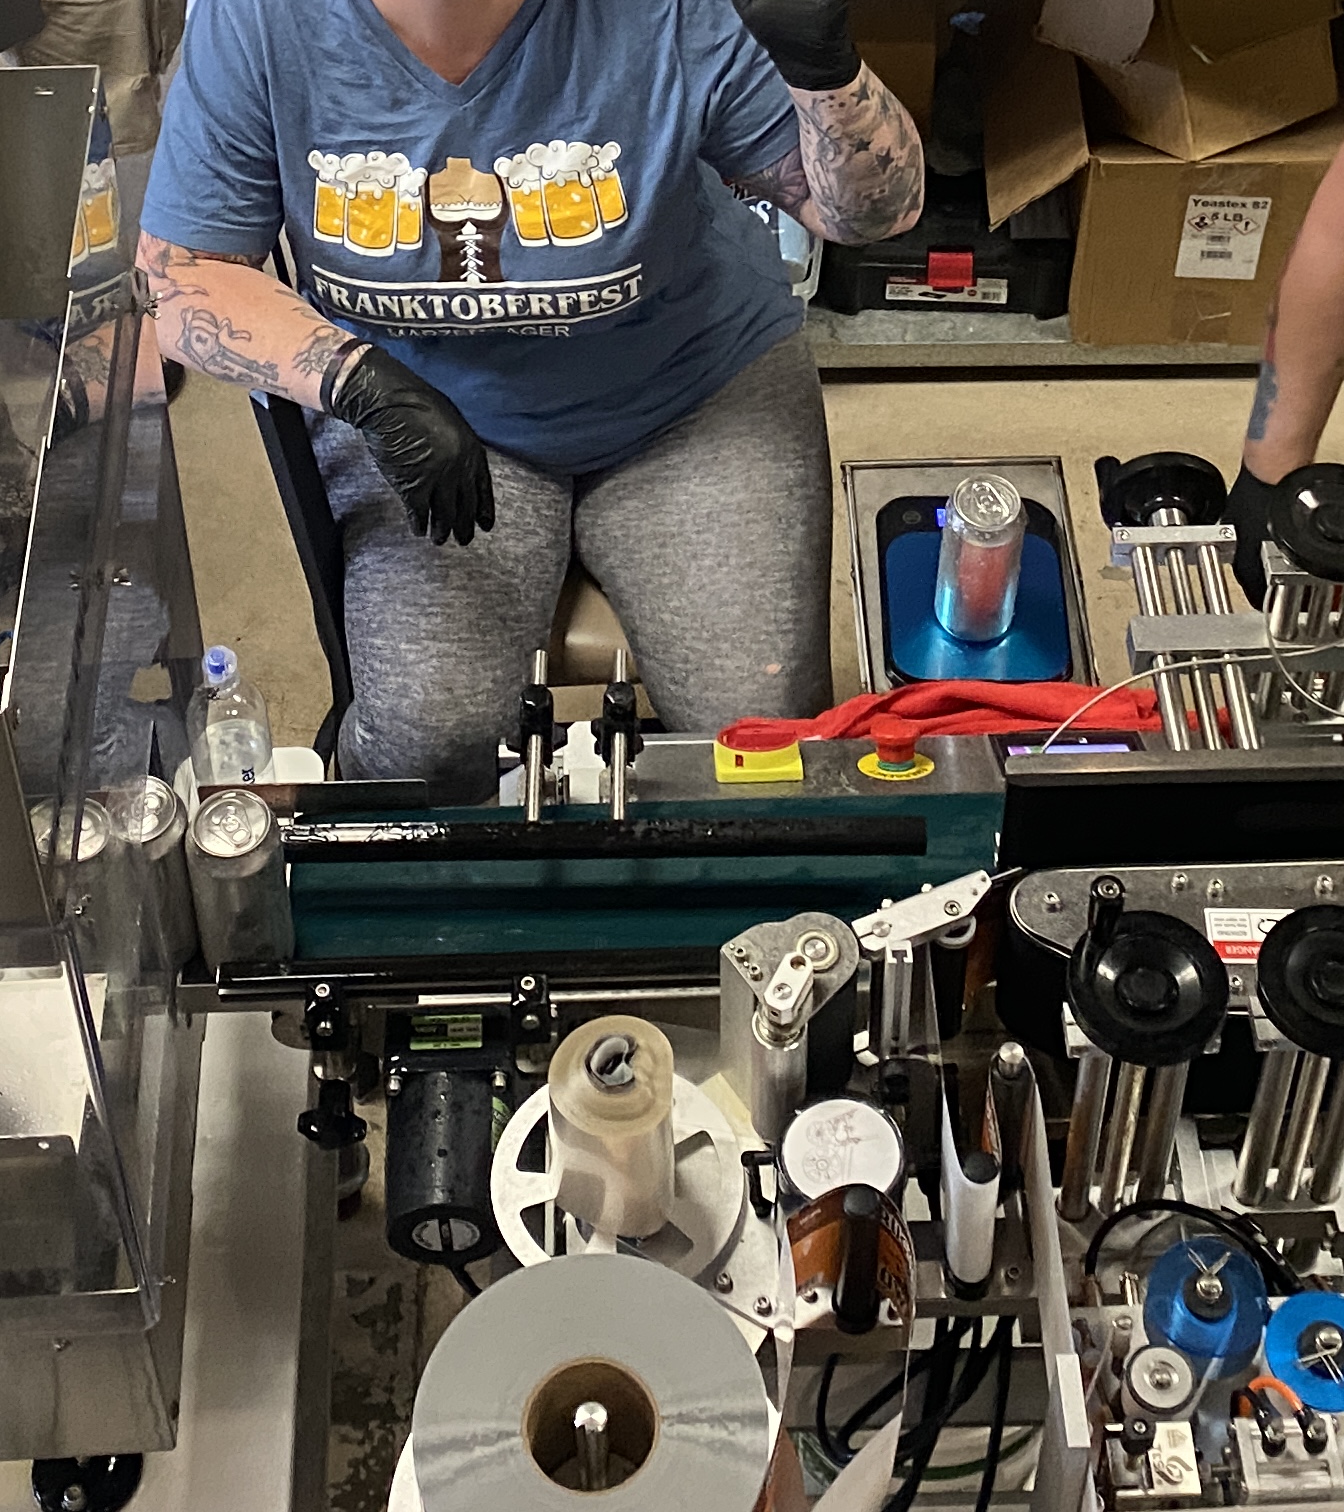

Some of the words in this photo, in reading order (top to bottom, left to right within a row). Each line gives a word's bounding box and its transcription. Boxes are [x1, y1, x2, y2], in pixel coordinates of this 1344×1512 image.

[1192, 198, 1248, 209] Yeastex
[1223, 213, 1243, 222] LB
[312, 273, 643, 321] FRANKTOBERFEST
[1224, 944, 1260, 956] ANGER
